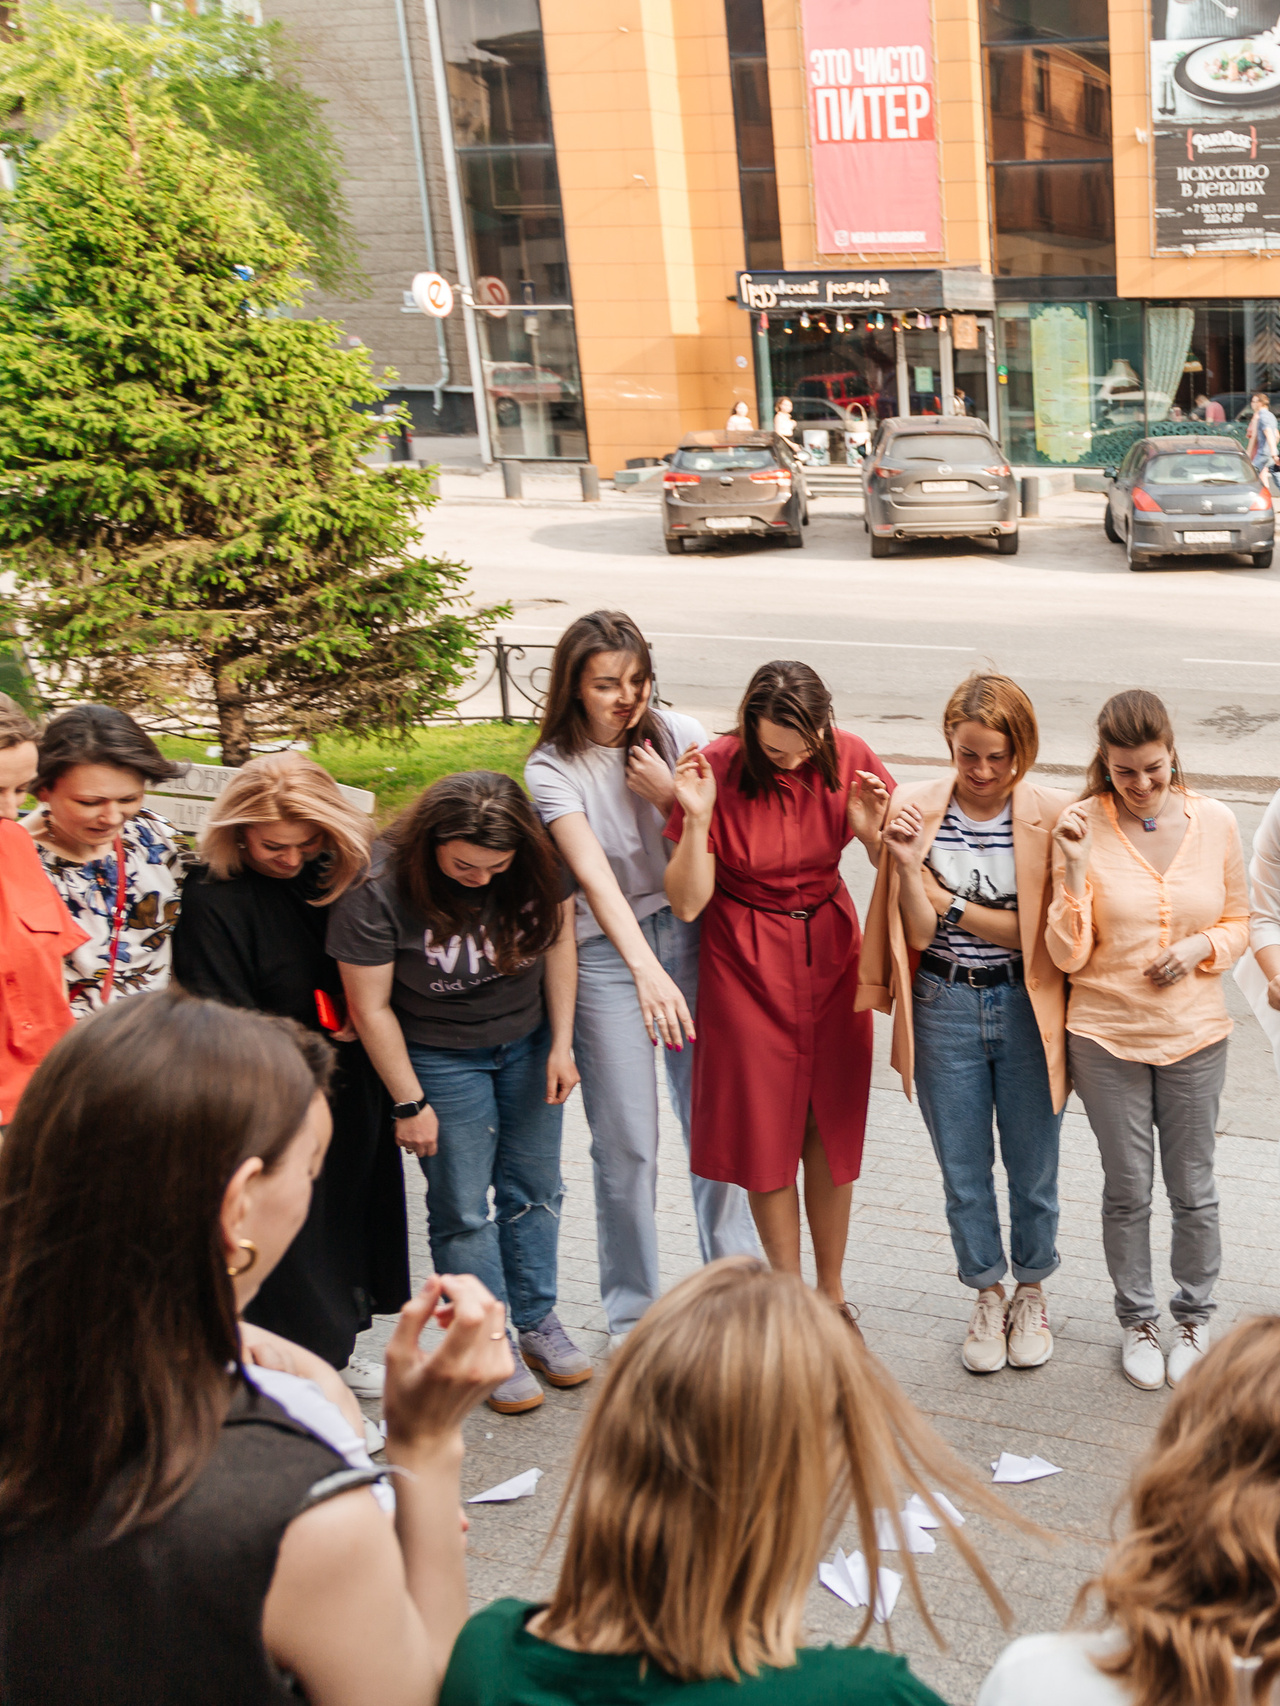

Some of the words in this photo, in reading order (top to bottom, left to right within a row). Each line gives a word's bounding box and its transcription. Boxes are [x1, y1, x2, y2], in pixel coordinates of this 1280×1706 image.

[810, 48, 852, 86] ЭТО
[853, 45, 926, 84] ЧИСТО
[815, 85, 930, 141] ПИТЕР
[1192, 130, 1252, 153] PARADISE
[1193, 203, 1200, 214] 7
[429, 978, 466, 992] did
